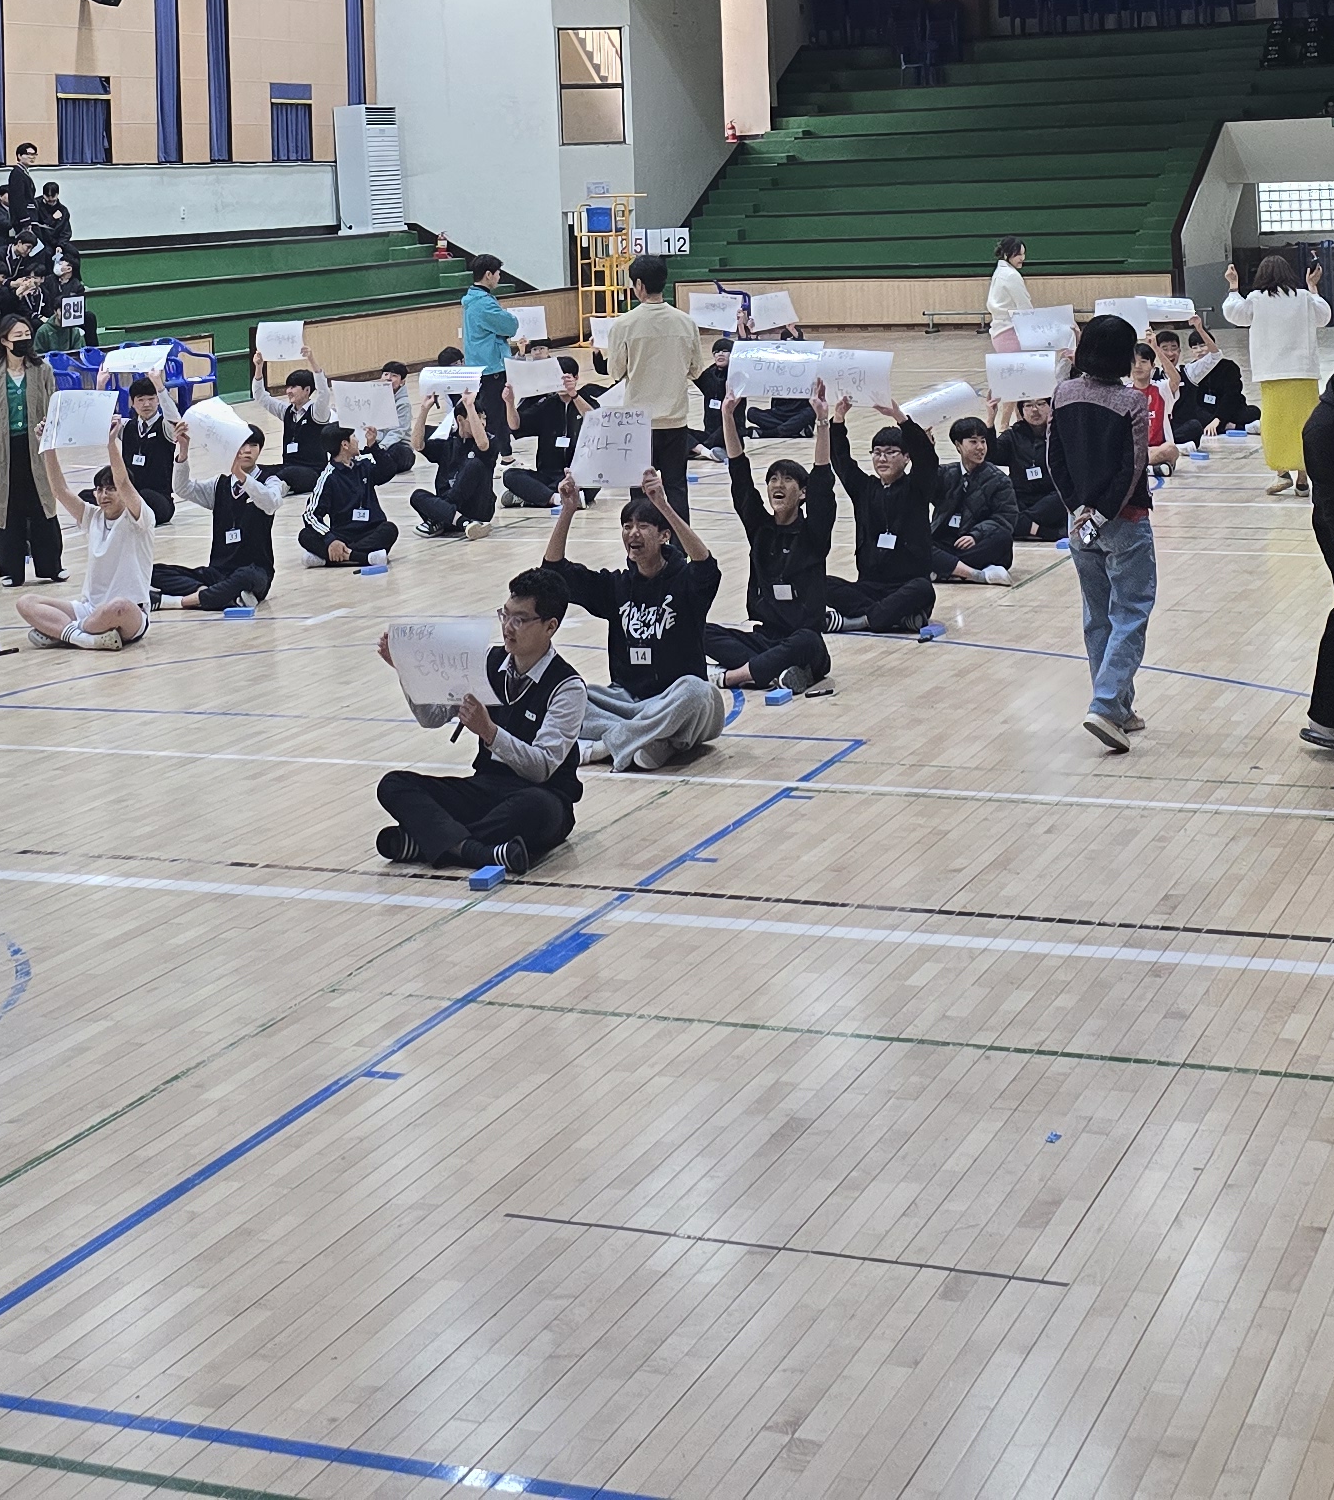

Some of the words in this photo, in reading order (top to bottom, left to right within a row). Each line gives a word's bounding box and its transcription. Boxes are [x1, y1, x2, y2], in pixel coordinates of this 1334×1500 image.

[664, 237, 687, 253] 12
[63, 301, 83, 320] 8반
[635, 650, 647, 661] 14
